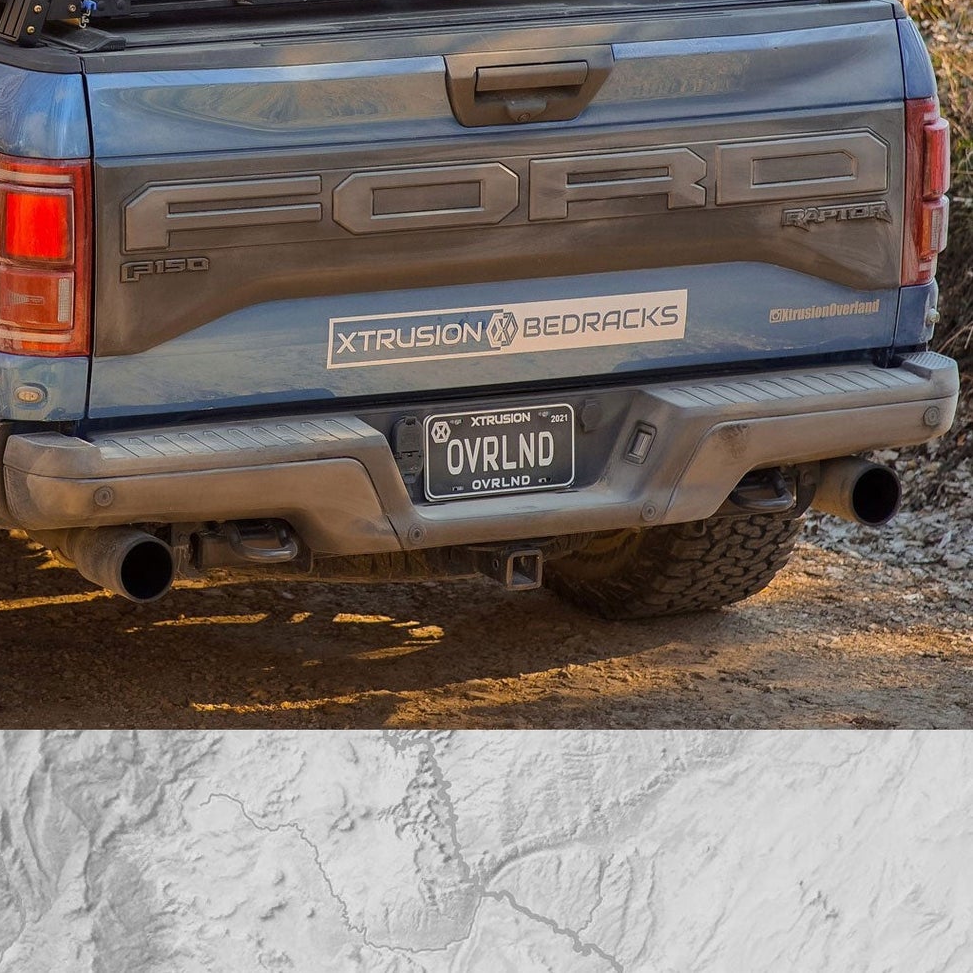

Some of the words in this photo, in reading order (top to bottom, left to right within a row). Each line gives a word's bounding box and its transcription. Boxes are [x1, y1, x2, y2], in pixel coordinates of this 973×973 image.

[121, 128, 890, 255] FORD
[781, 201, 892, 231] RAPTOR
[336, 321, 483, 354] XTRUSION
[522, 305, 679, 339] BEDRACKS
[471, 412, 531, 427] XTRUSION
[550, 414, 568, 423] 2021
[447, 431, 554, 475] OVRLND
[472, 475, 531, 490] OVRLND
